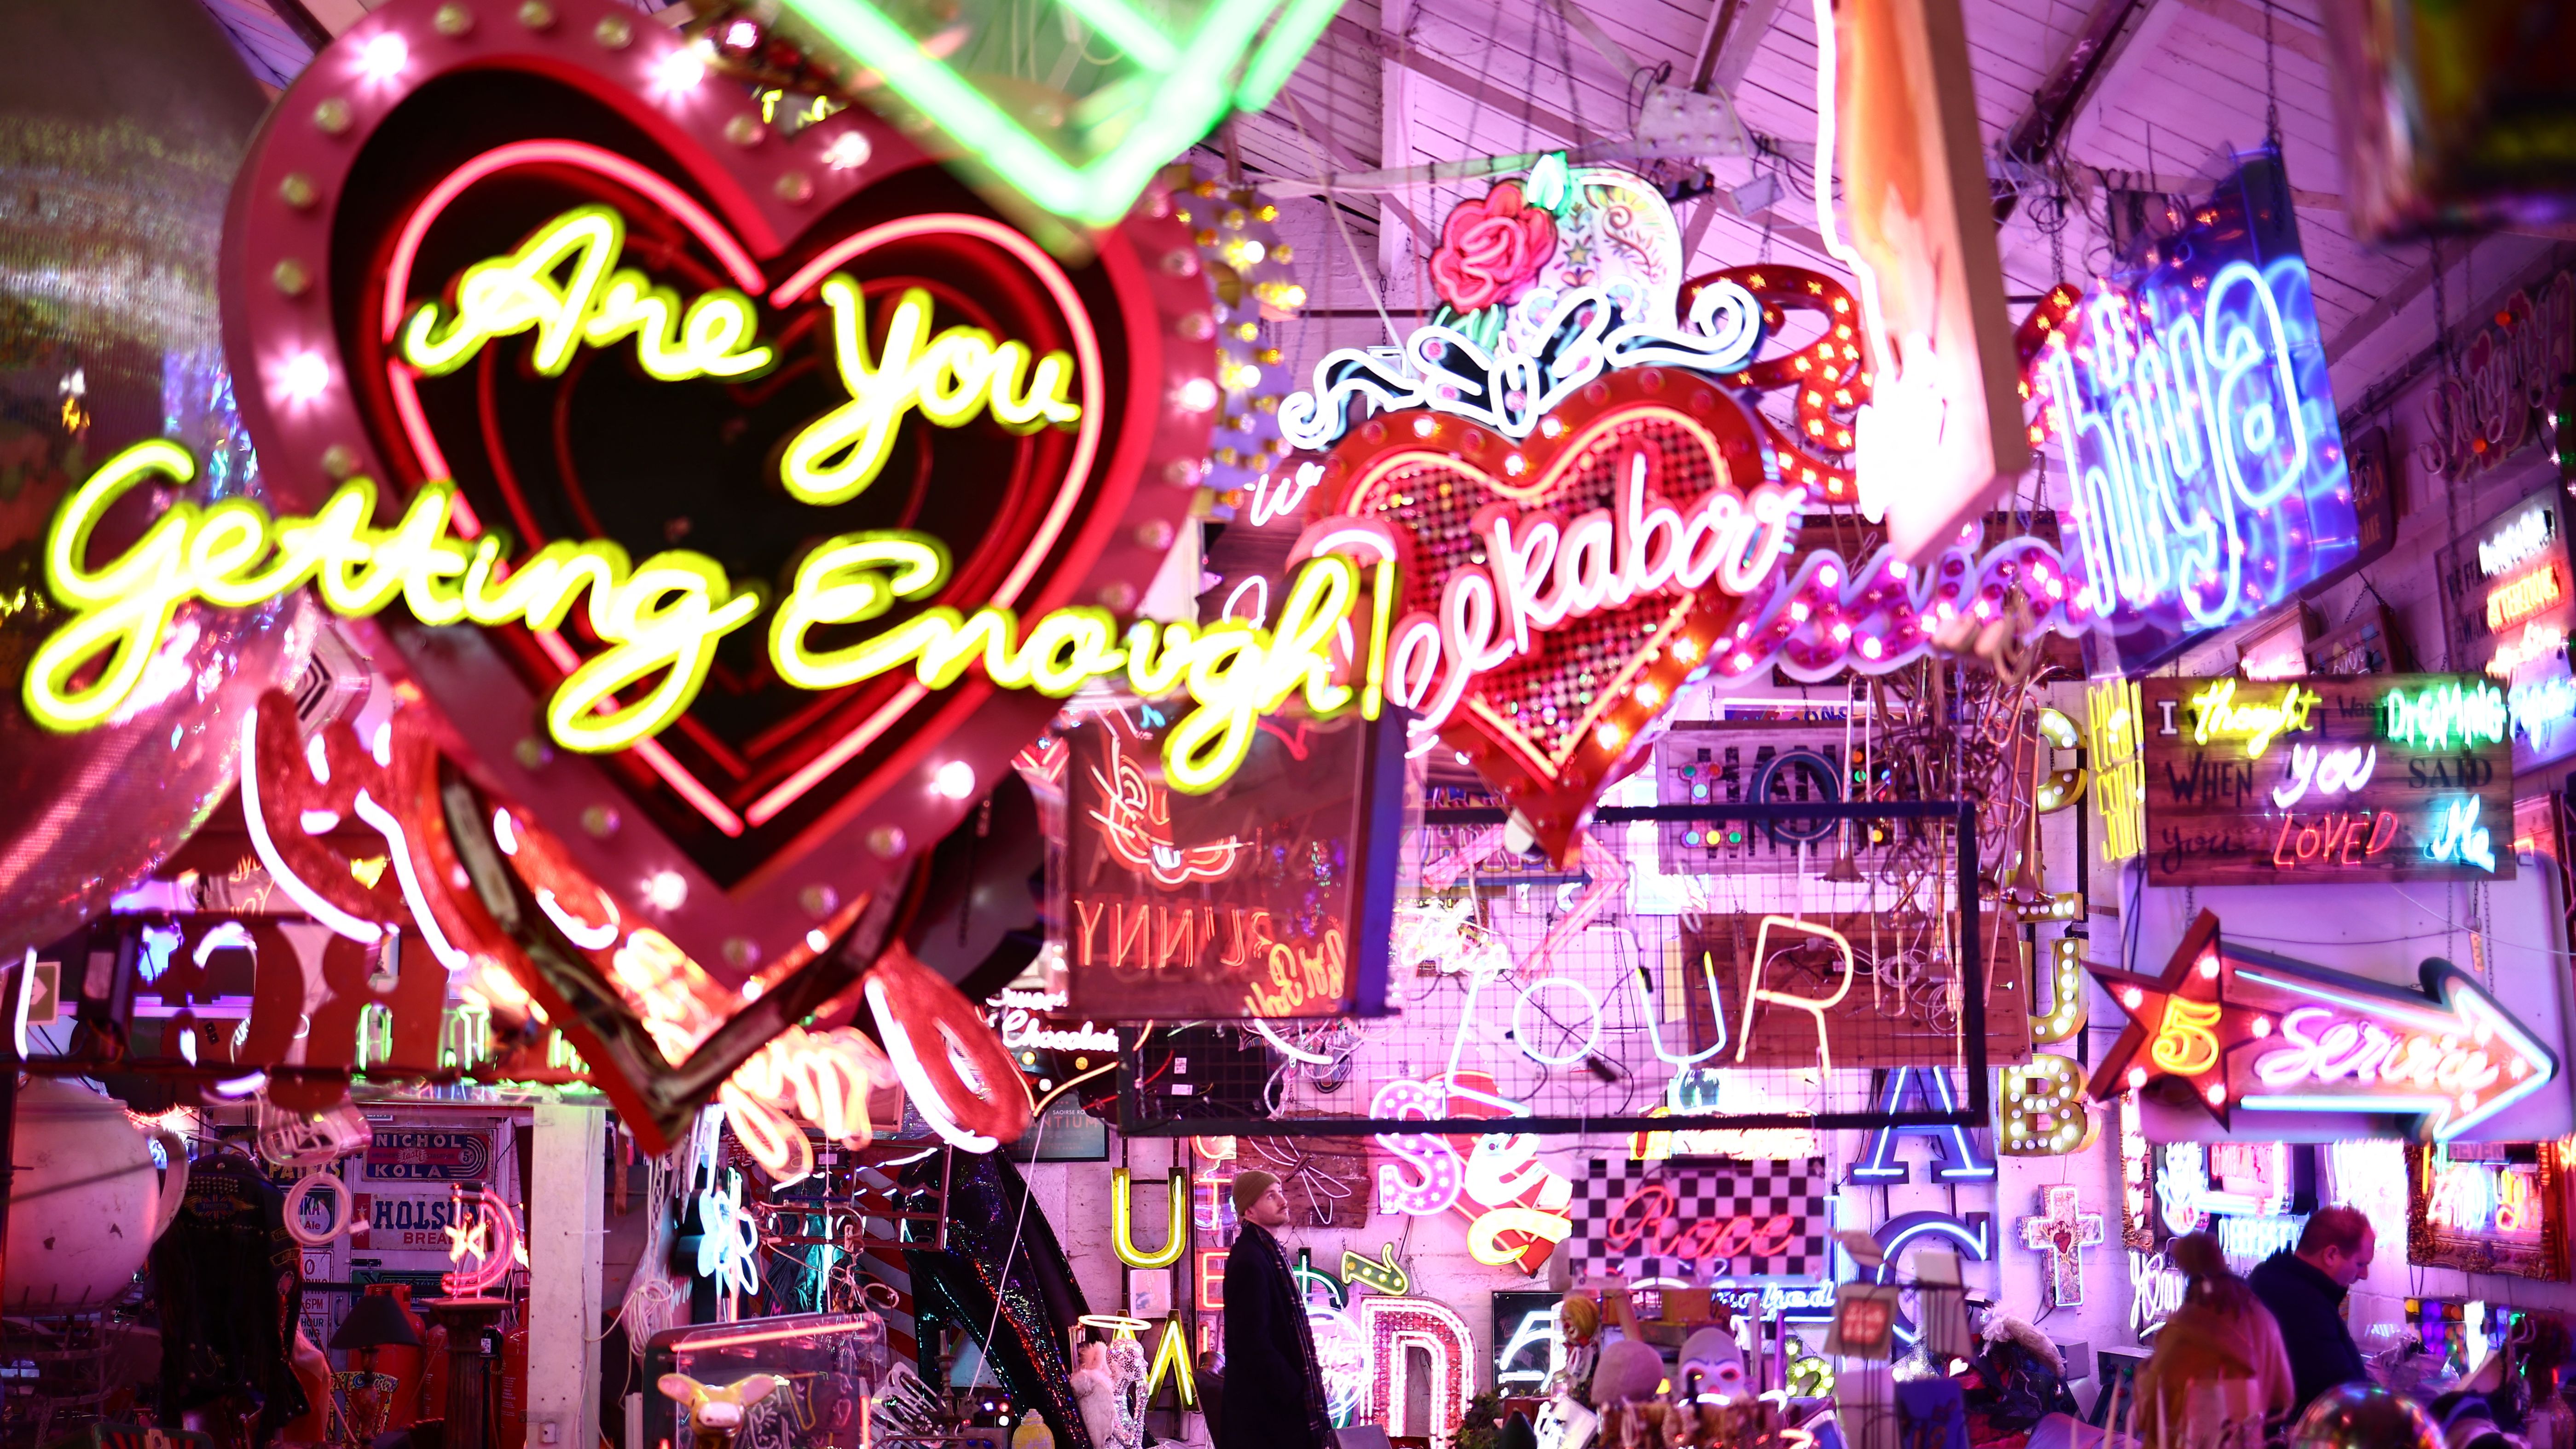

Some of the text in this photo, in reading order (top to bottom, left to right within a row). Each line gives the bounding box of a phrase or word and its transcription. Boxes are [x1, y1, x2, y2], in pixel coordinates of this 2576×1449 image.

[403, 201, 1082, 504] Are You
[21, 438, 760, 753] Getting
[766, 530, 1397, 794] Enough!
[2157, 701, 2177, 735] I
[2192, 677, 2322, 759] thought
[2166, 742, 2493, 809] WHEN you SAID
[2273, 809, 2398, 870] LOVED
[2151, 992, 2500, 1087] 5 Service
[375, 1164, 442, 1177] KOLA
[376, 1134, 462, 1148] NICHOL
[304, 1221, 321, 1230] Ale
[403, 1232, 458, 1245] BREA
[1604, 1184, 1795, 1259] Race
[301, 1318, 324, 1327] HOUR
